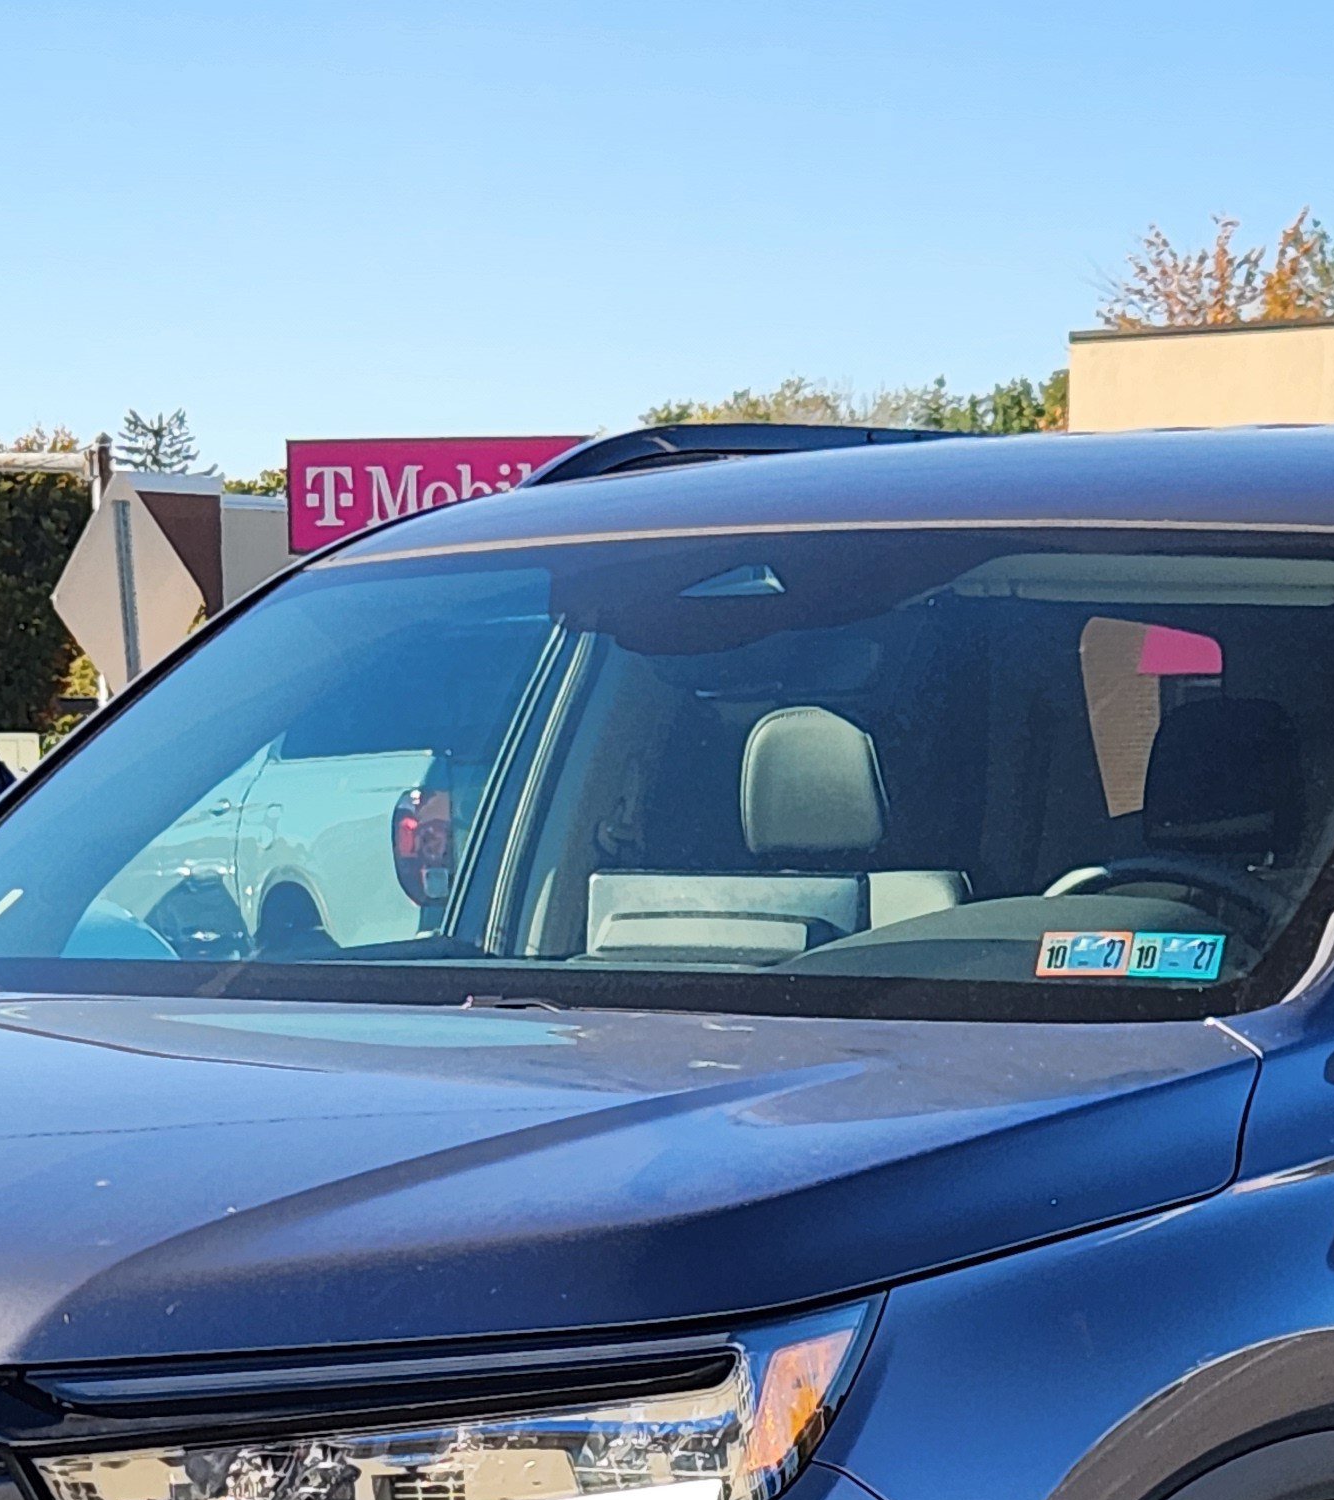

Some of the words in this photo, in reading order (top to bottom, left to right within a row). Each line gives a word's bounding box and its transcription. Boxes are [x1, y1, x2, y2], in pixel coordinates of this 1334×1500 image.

[1046, 944, 1068, 969] 10
[1102, 938, 1126, 970] 27
[1136, 944, 1158, 970] 10
[1193, 940, 1216, 971] 27
